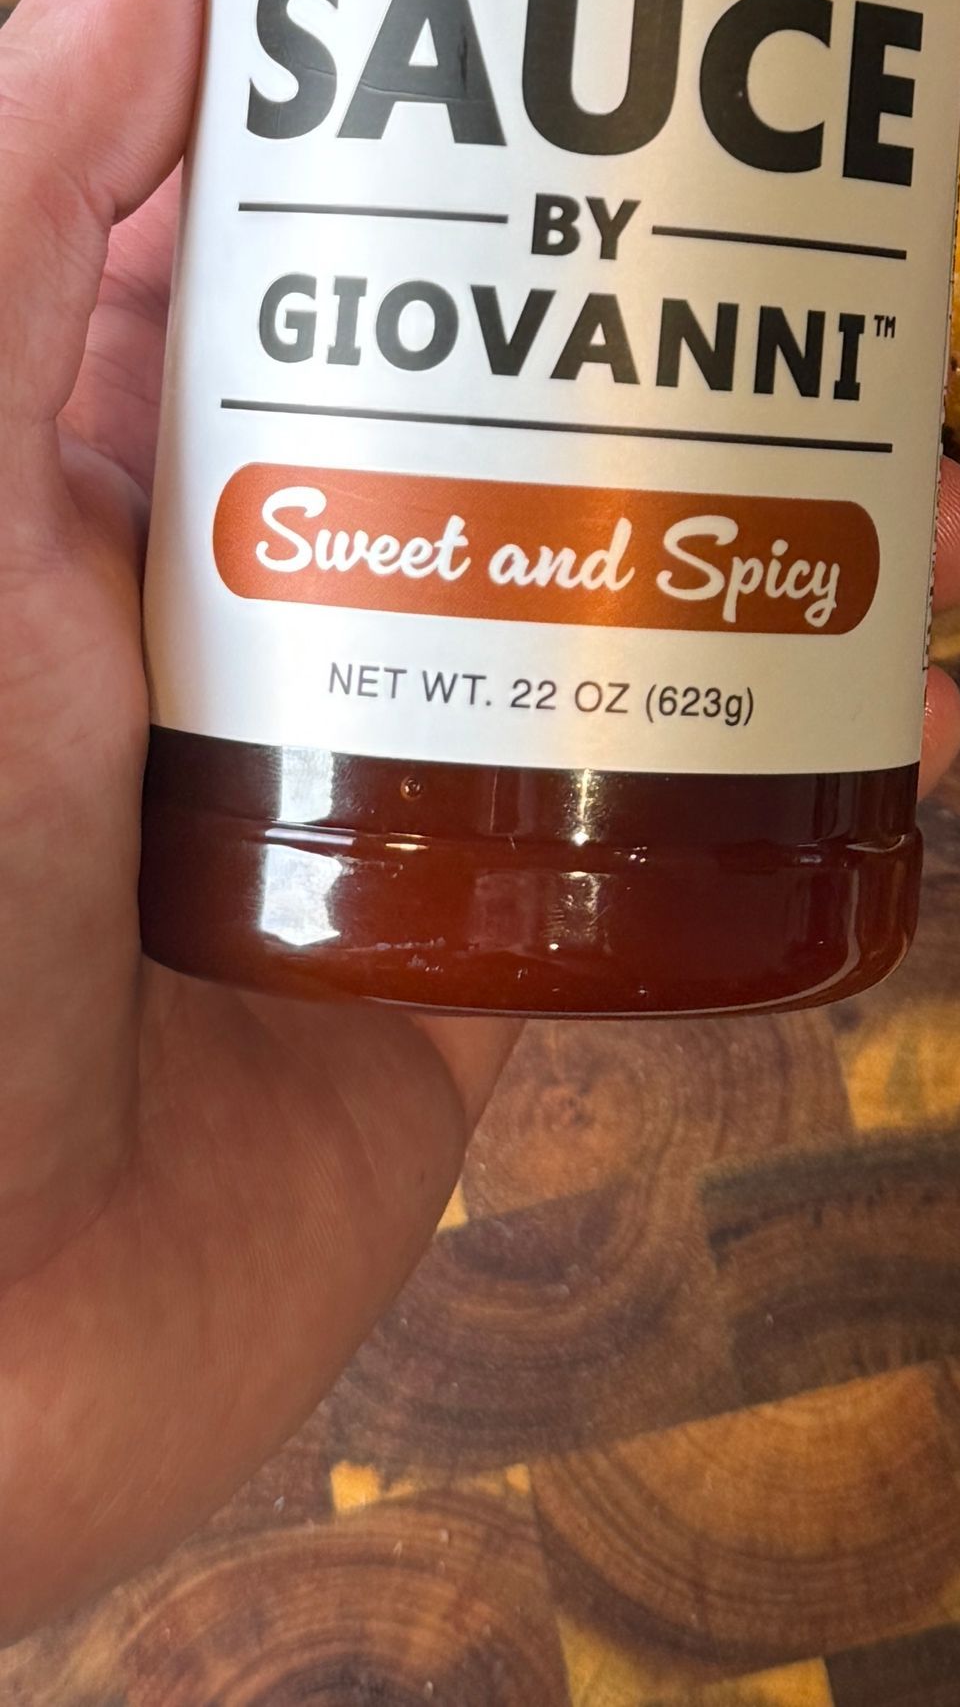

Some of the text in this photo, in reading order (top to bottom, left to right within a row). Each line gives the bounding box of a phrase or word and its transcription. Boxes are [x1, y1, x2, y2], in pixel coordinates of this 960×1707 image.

[531, 192, 642, 261] BY
[255, 486, 843, 627] Sweet and Spicy
[329, 662, 755, 728] NET WT. 22 OZ (623g)
